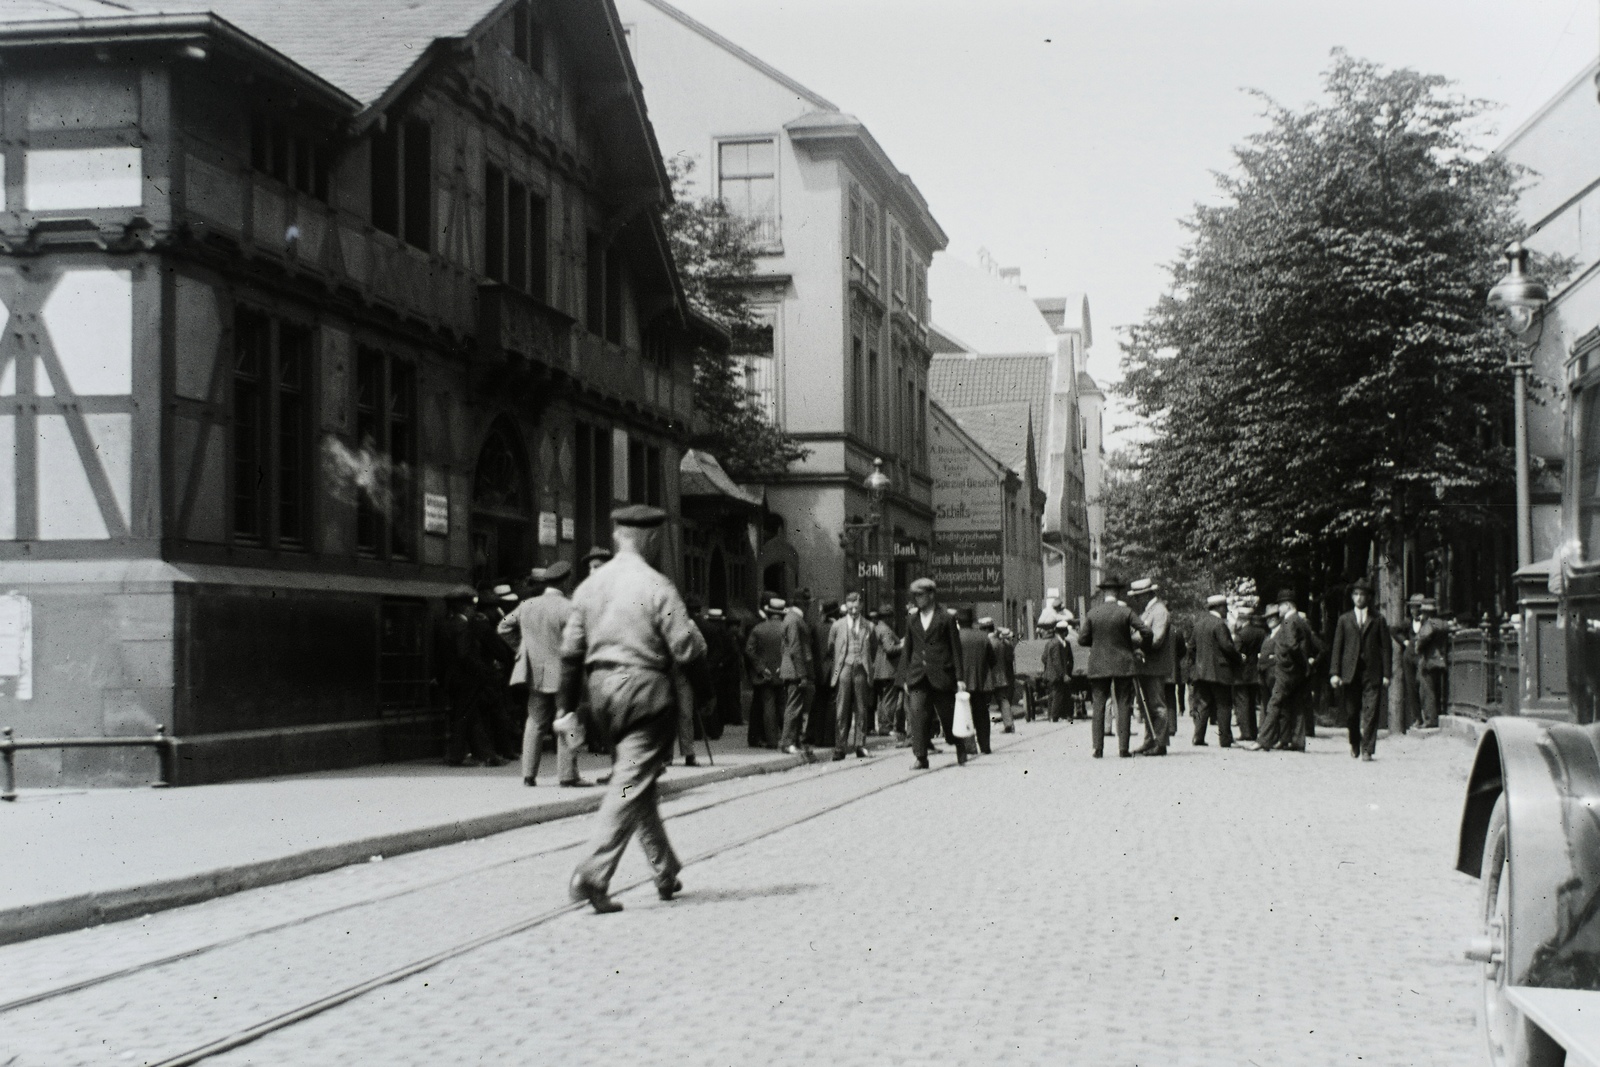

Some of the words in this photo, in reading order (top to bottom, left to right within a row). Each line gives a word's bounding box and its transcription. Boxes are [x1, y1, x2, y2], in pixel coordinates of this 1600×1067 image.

[893, 542, 917, 556] Bank
[858, 560, 884, 578] Bank
[987, 568, 1001, 584] My
